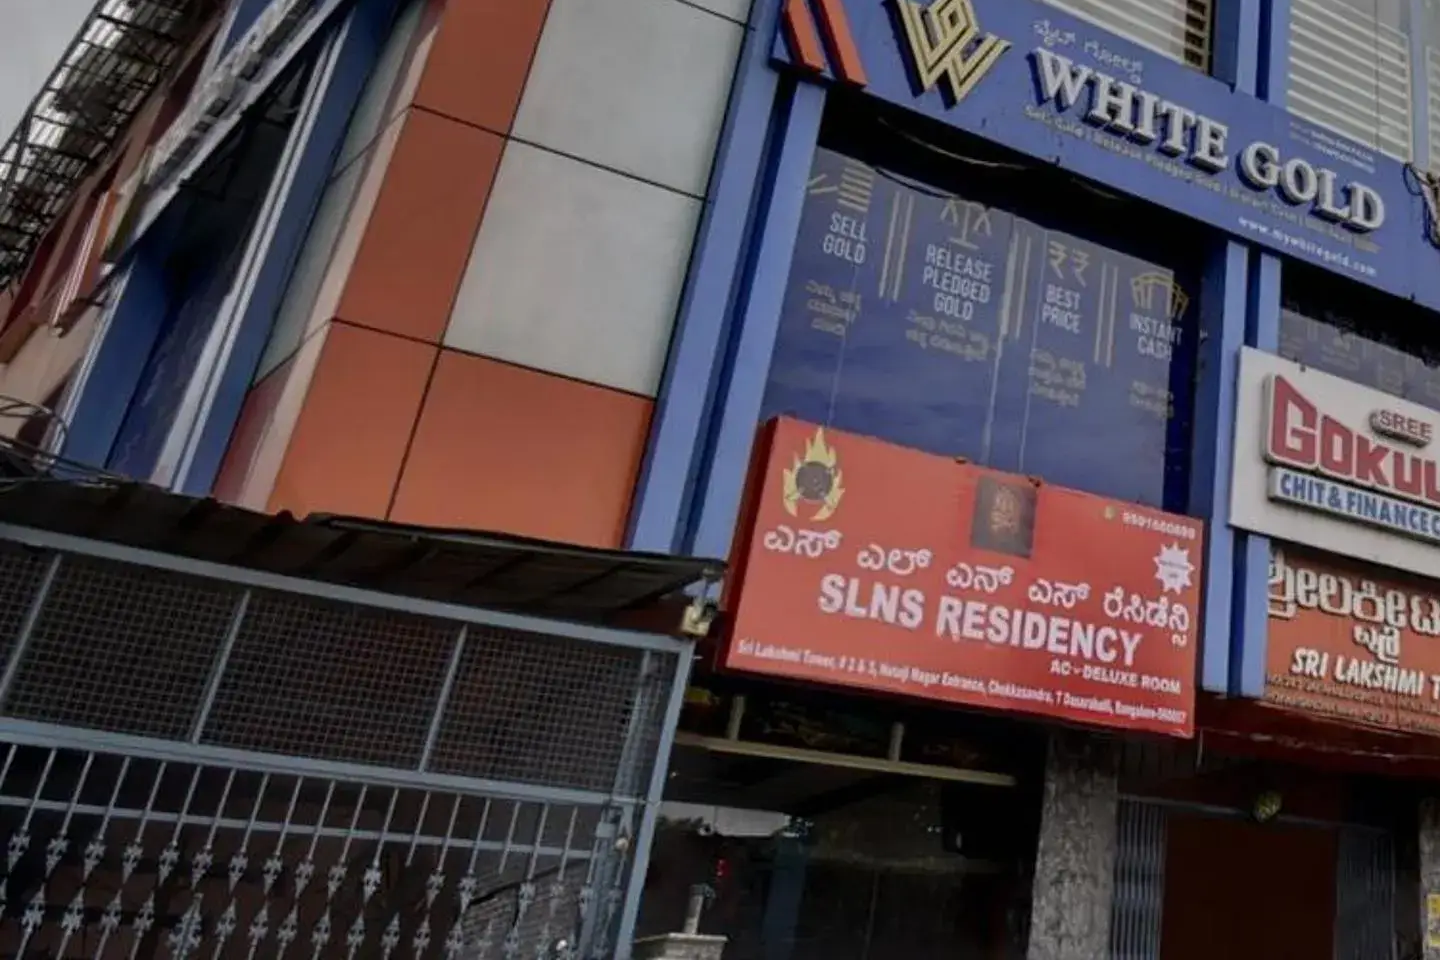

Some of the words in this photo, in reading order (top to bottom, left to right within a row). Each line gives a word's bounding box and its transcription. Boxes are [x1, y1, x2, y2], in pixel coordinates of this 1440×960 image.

[1034, 47, 1228, 169] WHITE
[1239, 141, 1386, 231] GOLD
[829, 211, 867, 241] SELL
[822, 234, 867, 264] GOLD
[924, 243, 994, 283] RELEASE
[922, 266, 991, 304] PLEDGED
[1045, 284, 1081, 310] BEST
[933, 292, 974, 320] GOLD
[1042, 304, 1081, 334] PRICE
[1137, 335, 1173, 361] CASH
[1378, 409, 1433, 439] SREE
[1279, 473, 1326, 508] CHIT
[763, 524, 843, 558] ಎಸ್
[857, 543, 933, 576] ಎಲ್
[946, 562, 1015, 594] ಎನ್
[1028, 578, 1092, 609] ಎಸ್
[818, 573, 926, 630] SLNS
[935, 594, 1142, 667] RESIDENCY
[1050, 659, 1073, 677] AC
[1082, 665, 1139, 689] DELUXE
[1141, 674, 1181, 696] ROOM
[1290, 647, 1328, 677] SRI
[1334, 654, 1424, 696] LAKSHMI
